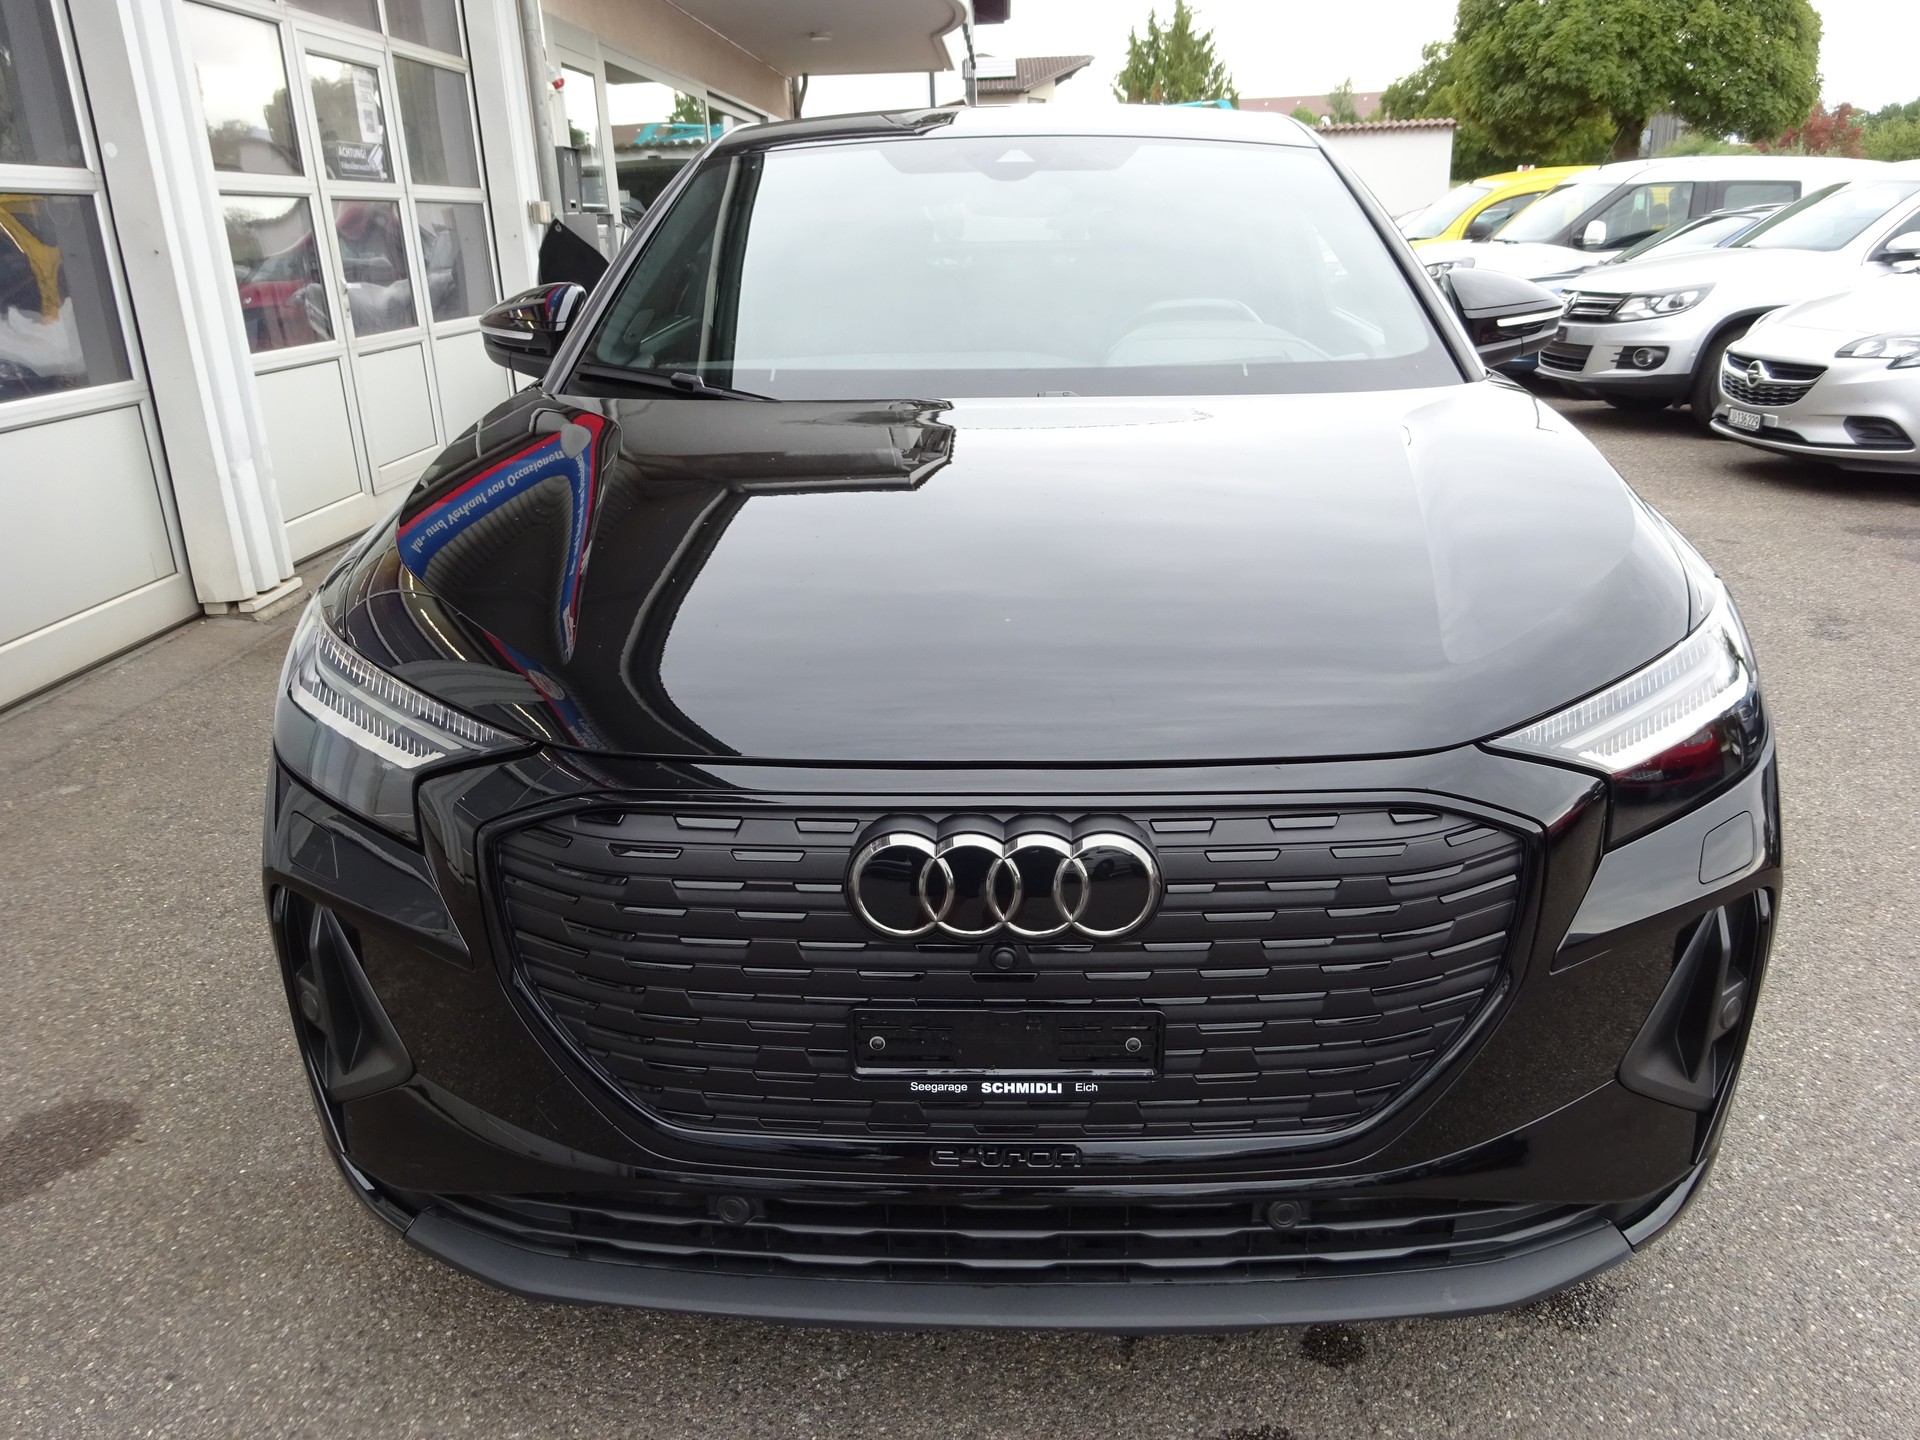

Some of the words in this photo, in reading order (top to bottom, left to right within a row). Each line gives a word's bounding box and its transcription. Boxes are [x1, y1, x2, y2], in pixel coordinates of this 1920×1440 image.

[910, 1081, 968, 1092] Seegarage
[981, 1082, 1062, 1094] SCHMIDLI
[1075, 1082, 1098, 1092] Eich
[930, 1145, 1082, 1168] e-tron
